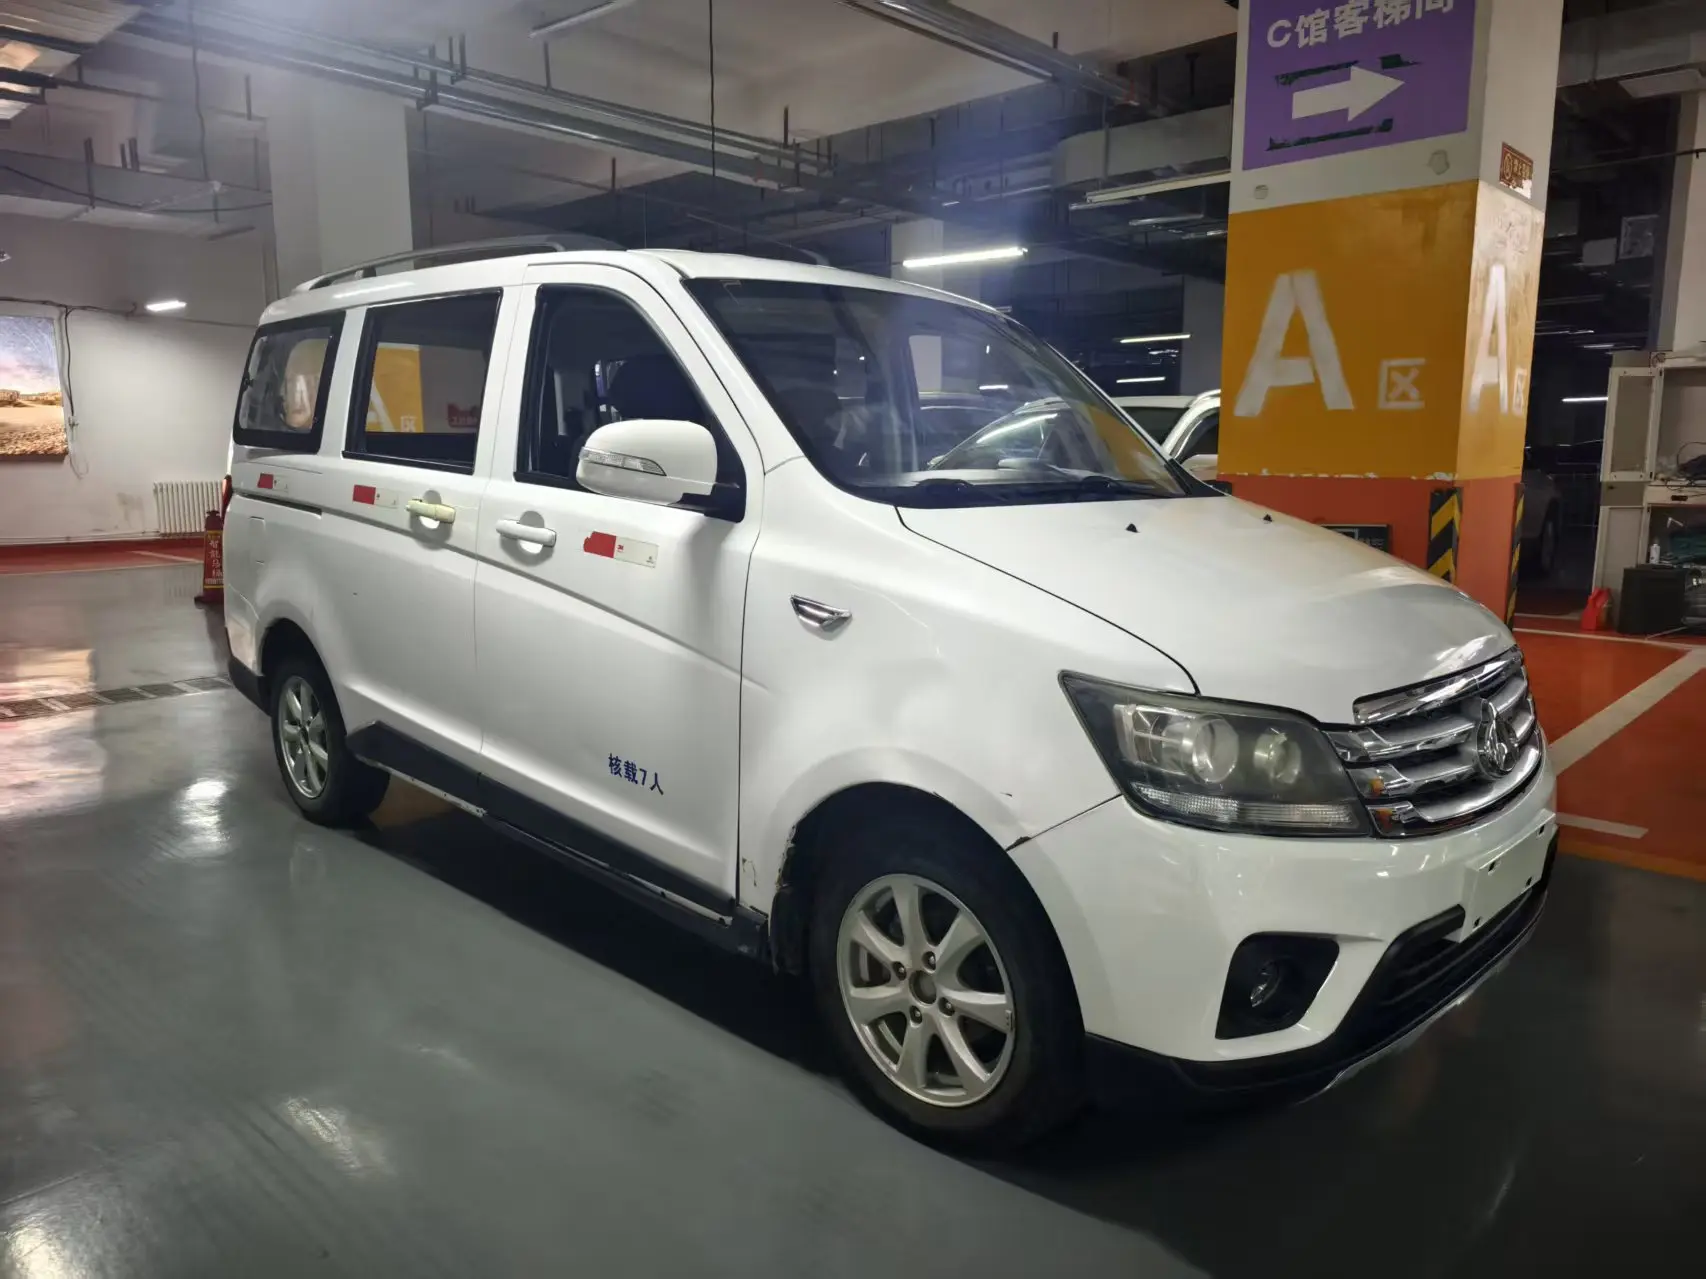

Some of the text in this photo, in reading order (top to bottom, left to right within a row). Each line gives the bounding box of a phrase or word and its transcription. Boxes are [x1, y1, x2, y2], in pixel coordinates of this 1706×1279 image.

[1233, 268, 1425, 417] A区
[1467, 263, 1527, 415] A区
[608, 752, 664, 796] 核载7人
